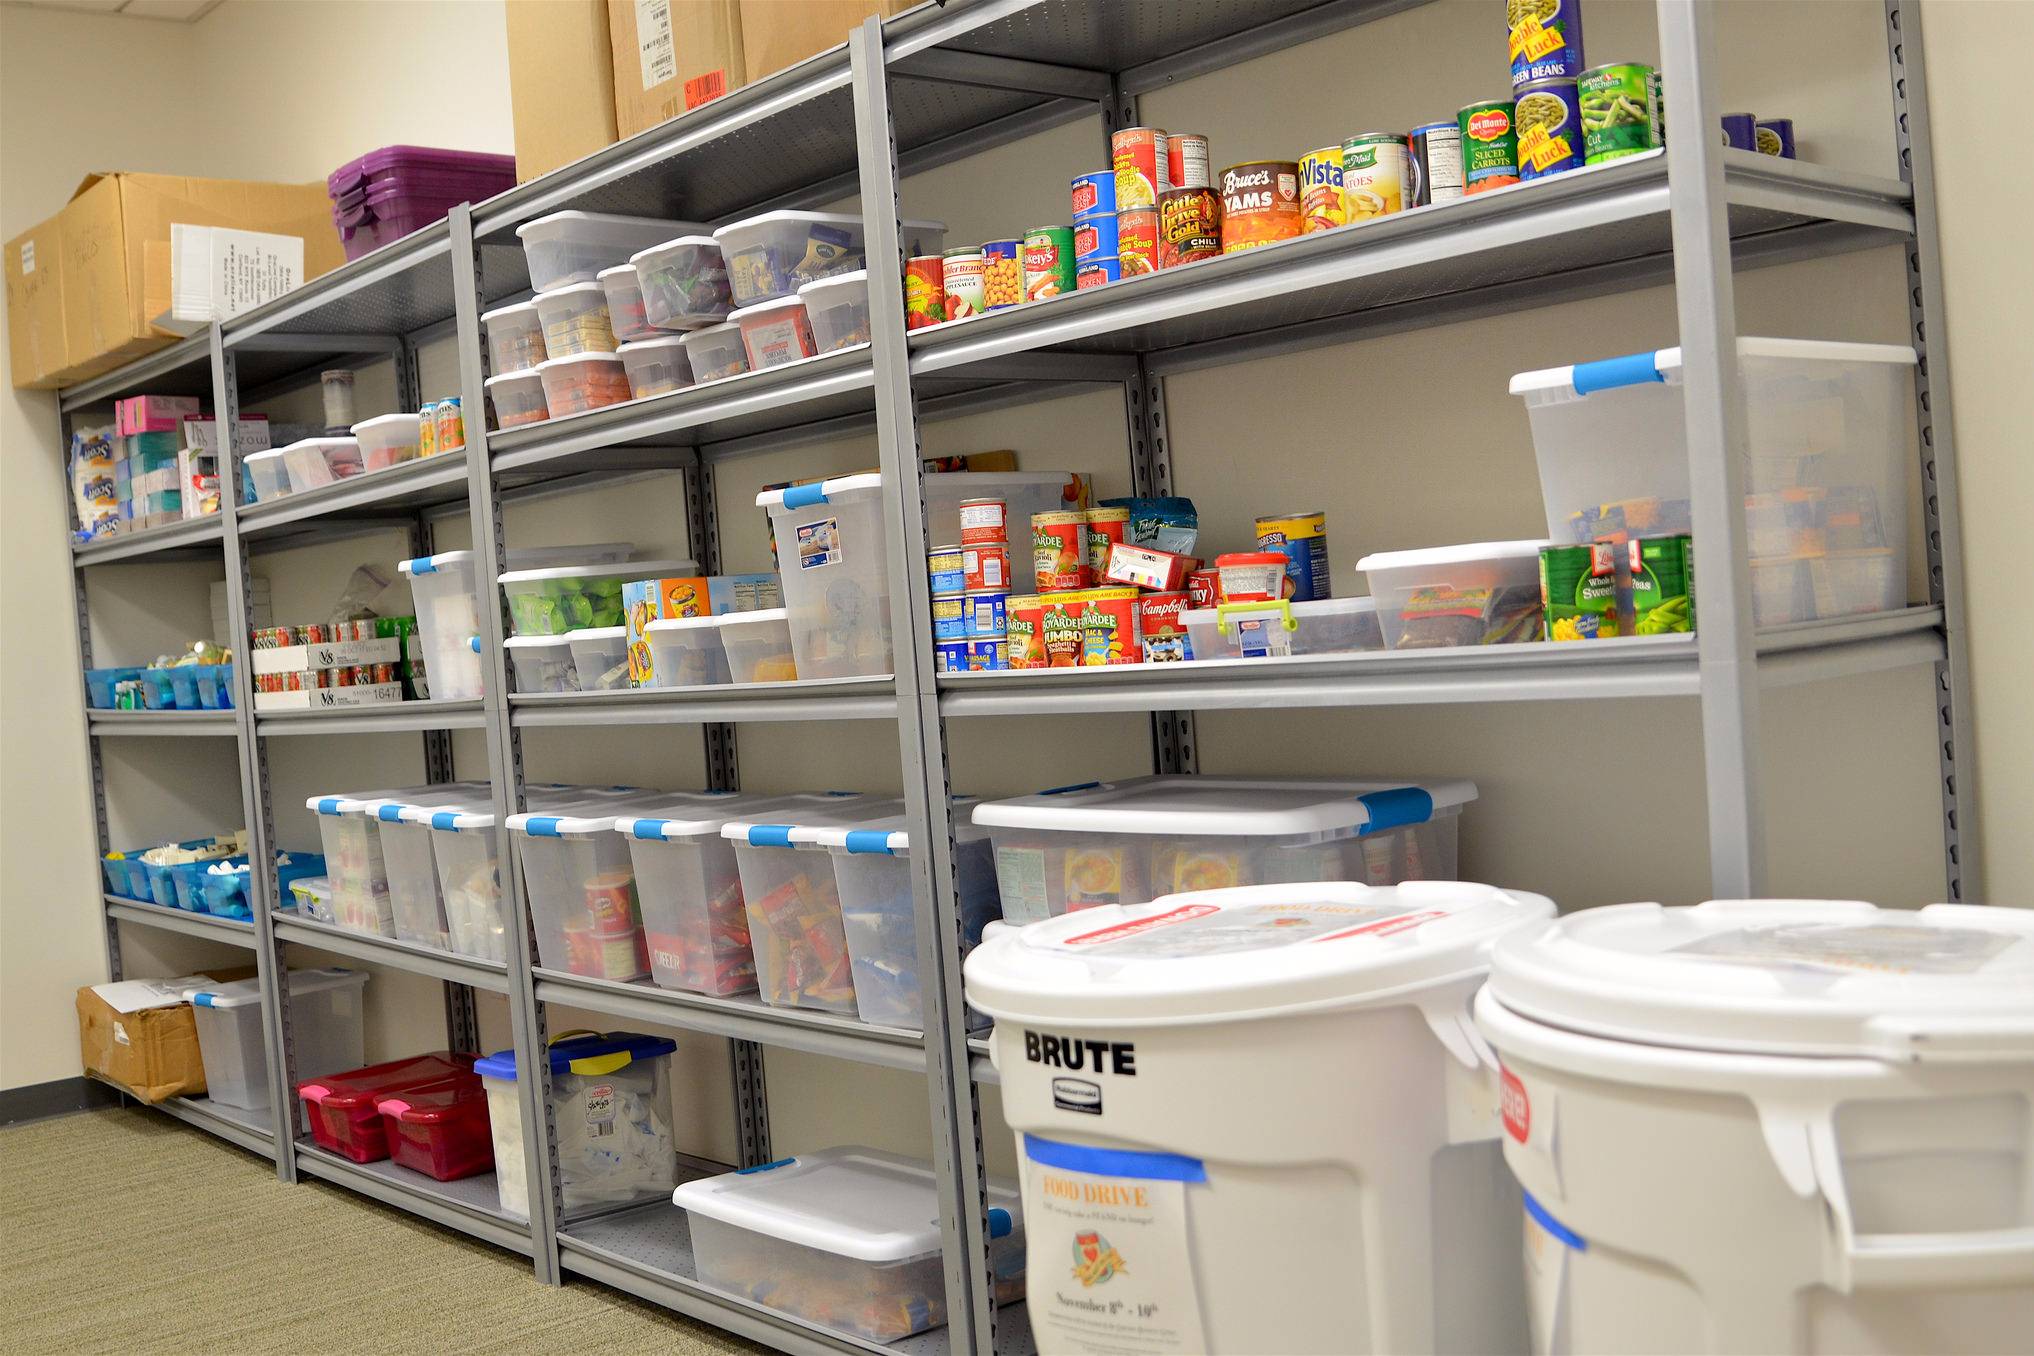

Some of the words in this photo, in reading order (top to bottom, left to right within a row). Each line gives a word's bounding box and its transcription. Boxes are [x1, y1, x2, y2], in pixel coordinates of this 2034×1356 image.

[1525, 30, 1561, 59] Luck
[1531, 63, 1566, 79] BEANS
[1470, 121, 1481, 131] Del
[1481, 118, 1507, 129] Monte
[1518, 127, 1547, 158] ouble
[1587, 133, 1601, 146] Cut
[1474, 149, 1505, 161] SLICED
[1531, 140, 1568, 168] Luck
[1471, 157, 1511, 170] CARROTS
[1222, 169, 1270, 197] Bruce's
[1223, 191, 1273, 213] YAMS
[1167, 221, 1201, 243] Gold
[1133, 239, 1153, 250] Soup
[1190, 238, 1217, 246] CHILI
[1044, 629, 1083, 643] JUMBO
[320, 649, 334, 664] V8
[321, 689, 334, 706] V8
[1024, 1028, 1137, 1076] BRUTE
[1042, 1175, 1080, 1200] FOOD
[1083, 1182, 1153, 1209] DRIVE
[1056, 1291, 1106, 1313] November
